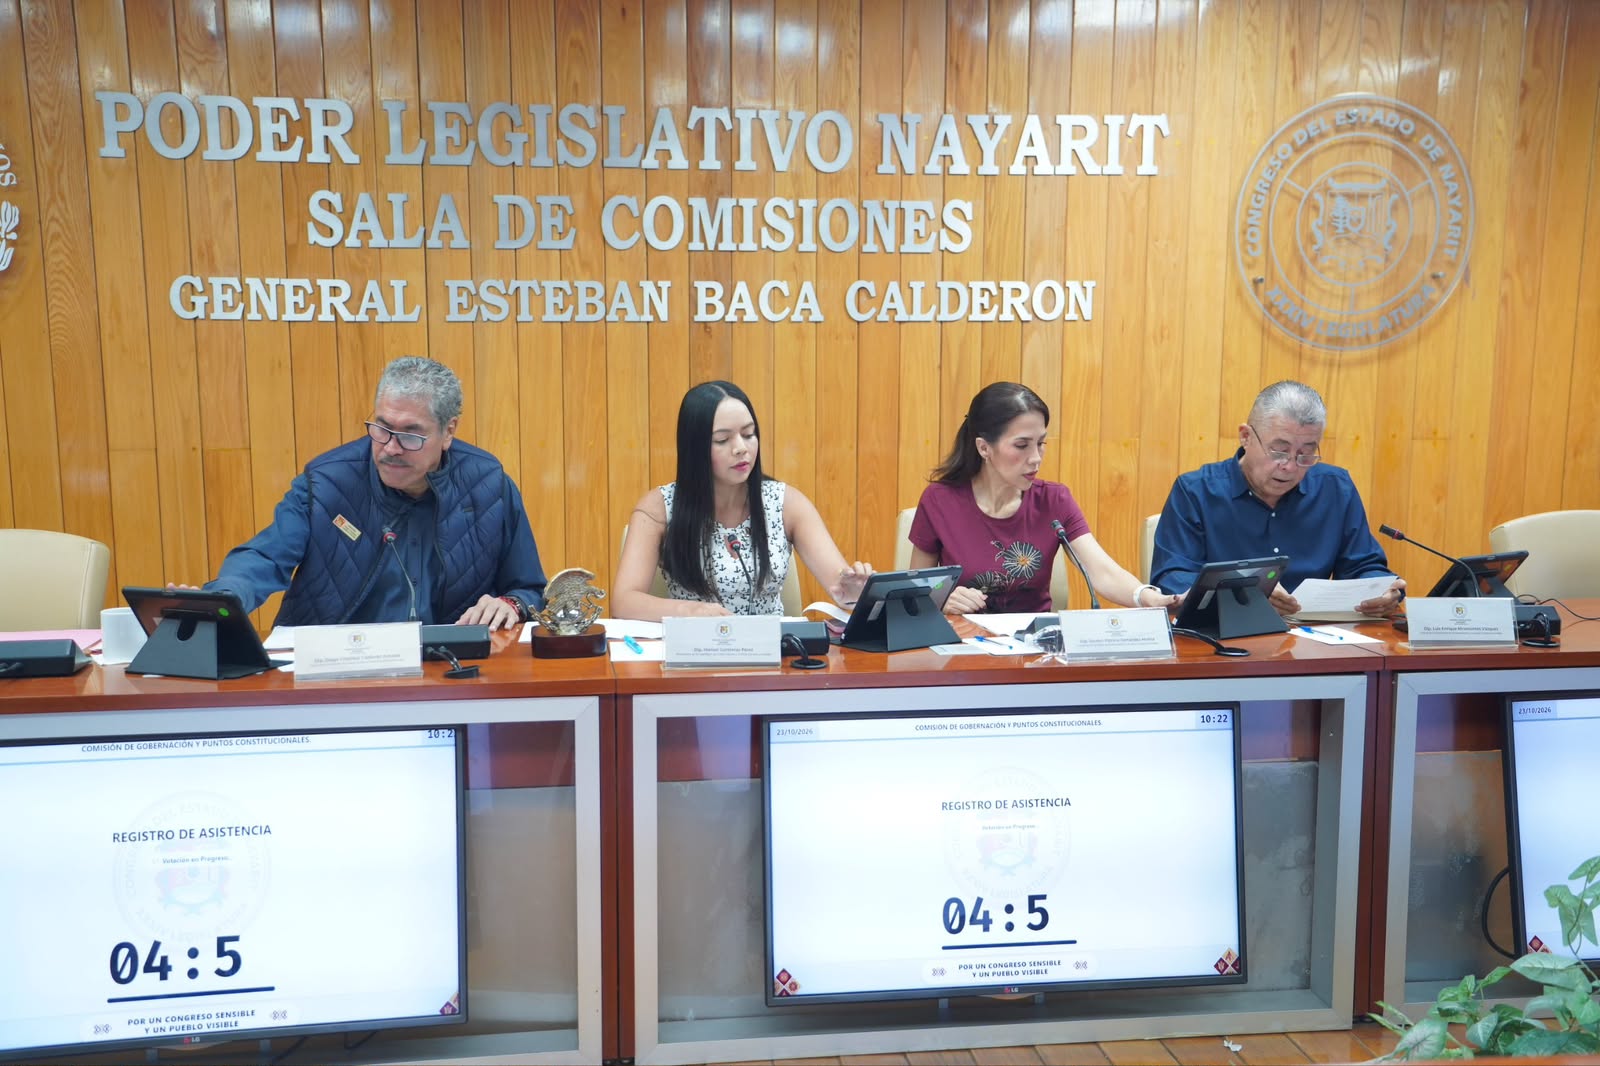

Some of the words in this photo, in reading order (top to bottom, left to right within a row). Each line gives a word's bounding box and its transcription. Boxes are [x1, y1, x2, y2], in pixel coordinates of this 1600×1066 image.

[95, 91, 360, 165] PODER
[381, 100, 853, 173] LEGISLATIVO
[876, 111, 1171, 176] NAYARIT
[1247, 142, 1294, 258] CONGRESO
[1293, 117, 1333, 146] DEL
[1335, 107, 1416, 136] ESTADO
[1419, 134, 1445, 161] DE
[1439, 164, 1464, 260] NAYARIT
[307, 190, 470, 249] SALA
[493, 194, 575, 249] DE
[601, 195, 974, 253] COMISIONES
[169, 275, 421, 321] GENERAL
[445, 280, 671, 322] ESTEBAN
[694, 280, 824, 322] BACA
[845, 279, 1097, 322] CALDERON
[1315, 284, 1437, 338] LEGISLATURA
[776, 728, 814, 736] 23/10/2026
[1013, 720, 1038, 728] PUNTOS
[1200, 714, 1228, 723] 10:22
[81, 742, 122, 753] COMISIÓN
[124, 743, 135, 751] DE
[136, 740, 194, 750] GOBERNACIÓN
[202, 739, 234, 748] PUNTOS
[941, 800, 992, 811] REGISTRO
[995, 800, 1008, 809] DE
[1011, 797, 1072, 809] ASISTENCIA
[112, 829, 175, 843] REGISTRO
[179, 828, 195, 840] DE
[199, 825, 272, 838] ASISTENCIA
[942, 893, 1050, 935] 04:5
[109, 935, 243, 985] 04:5
[988, 961, 1027, 969] CONGRESO
[128, 1018, 146, 1026] POR
[149, 1016, 162, 1024] UN
[165, 1013, 213, 1023] CONGRESO
[215, 1010, 256, 1019] SENSIBLE
[153, 1026, 166, 1034] UN
[169, 1023, 203, 1032] PUEBLO
[207, 1021, 239, 1029] VISIBLE
